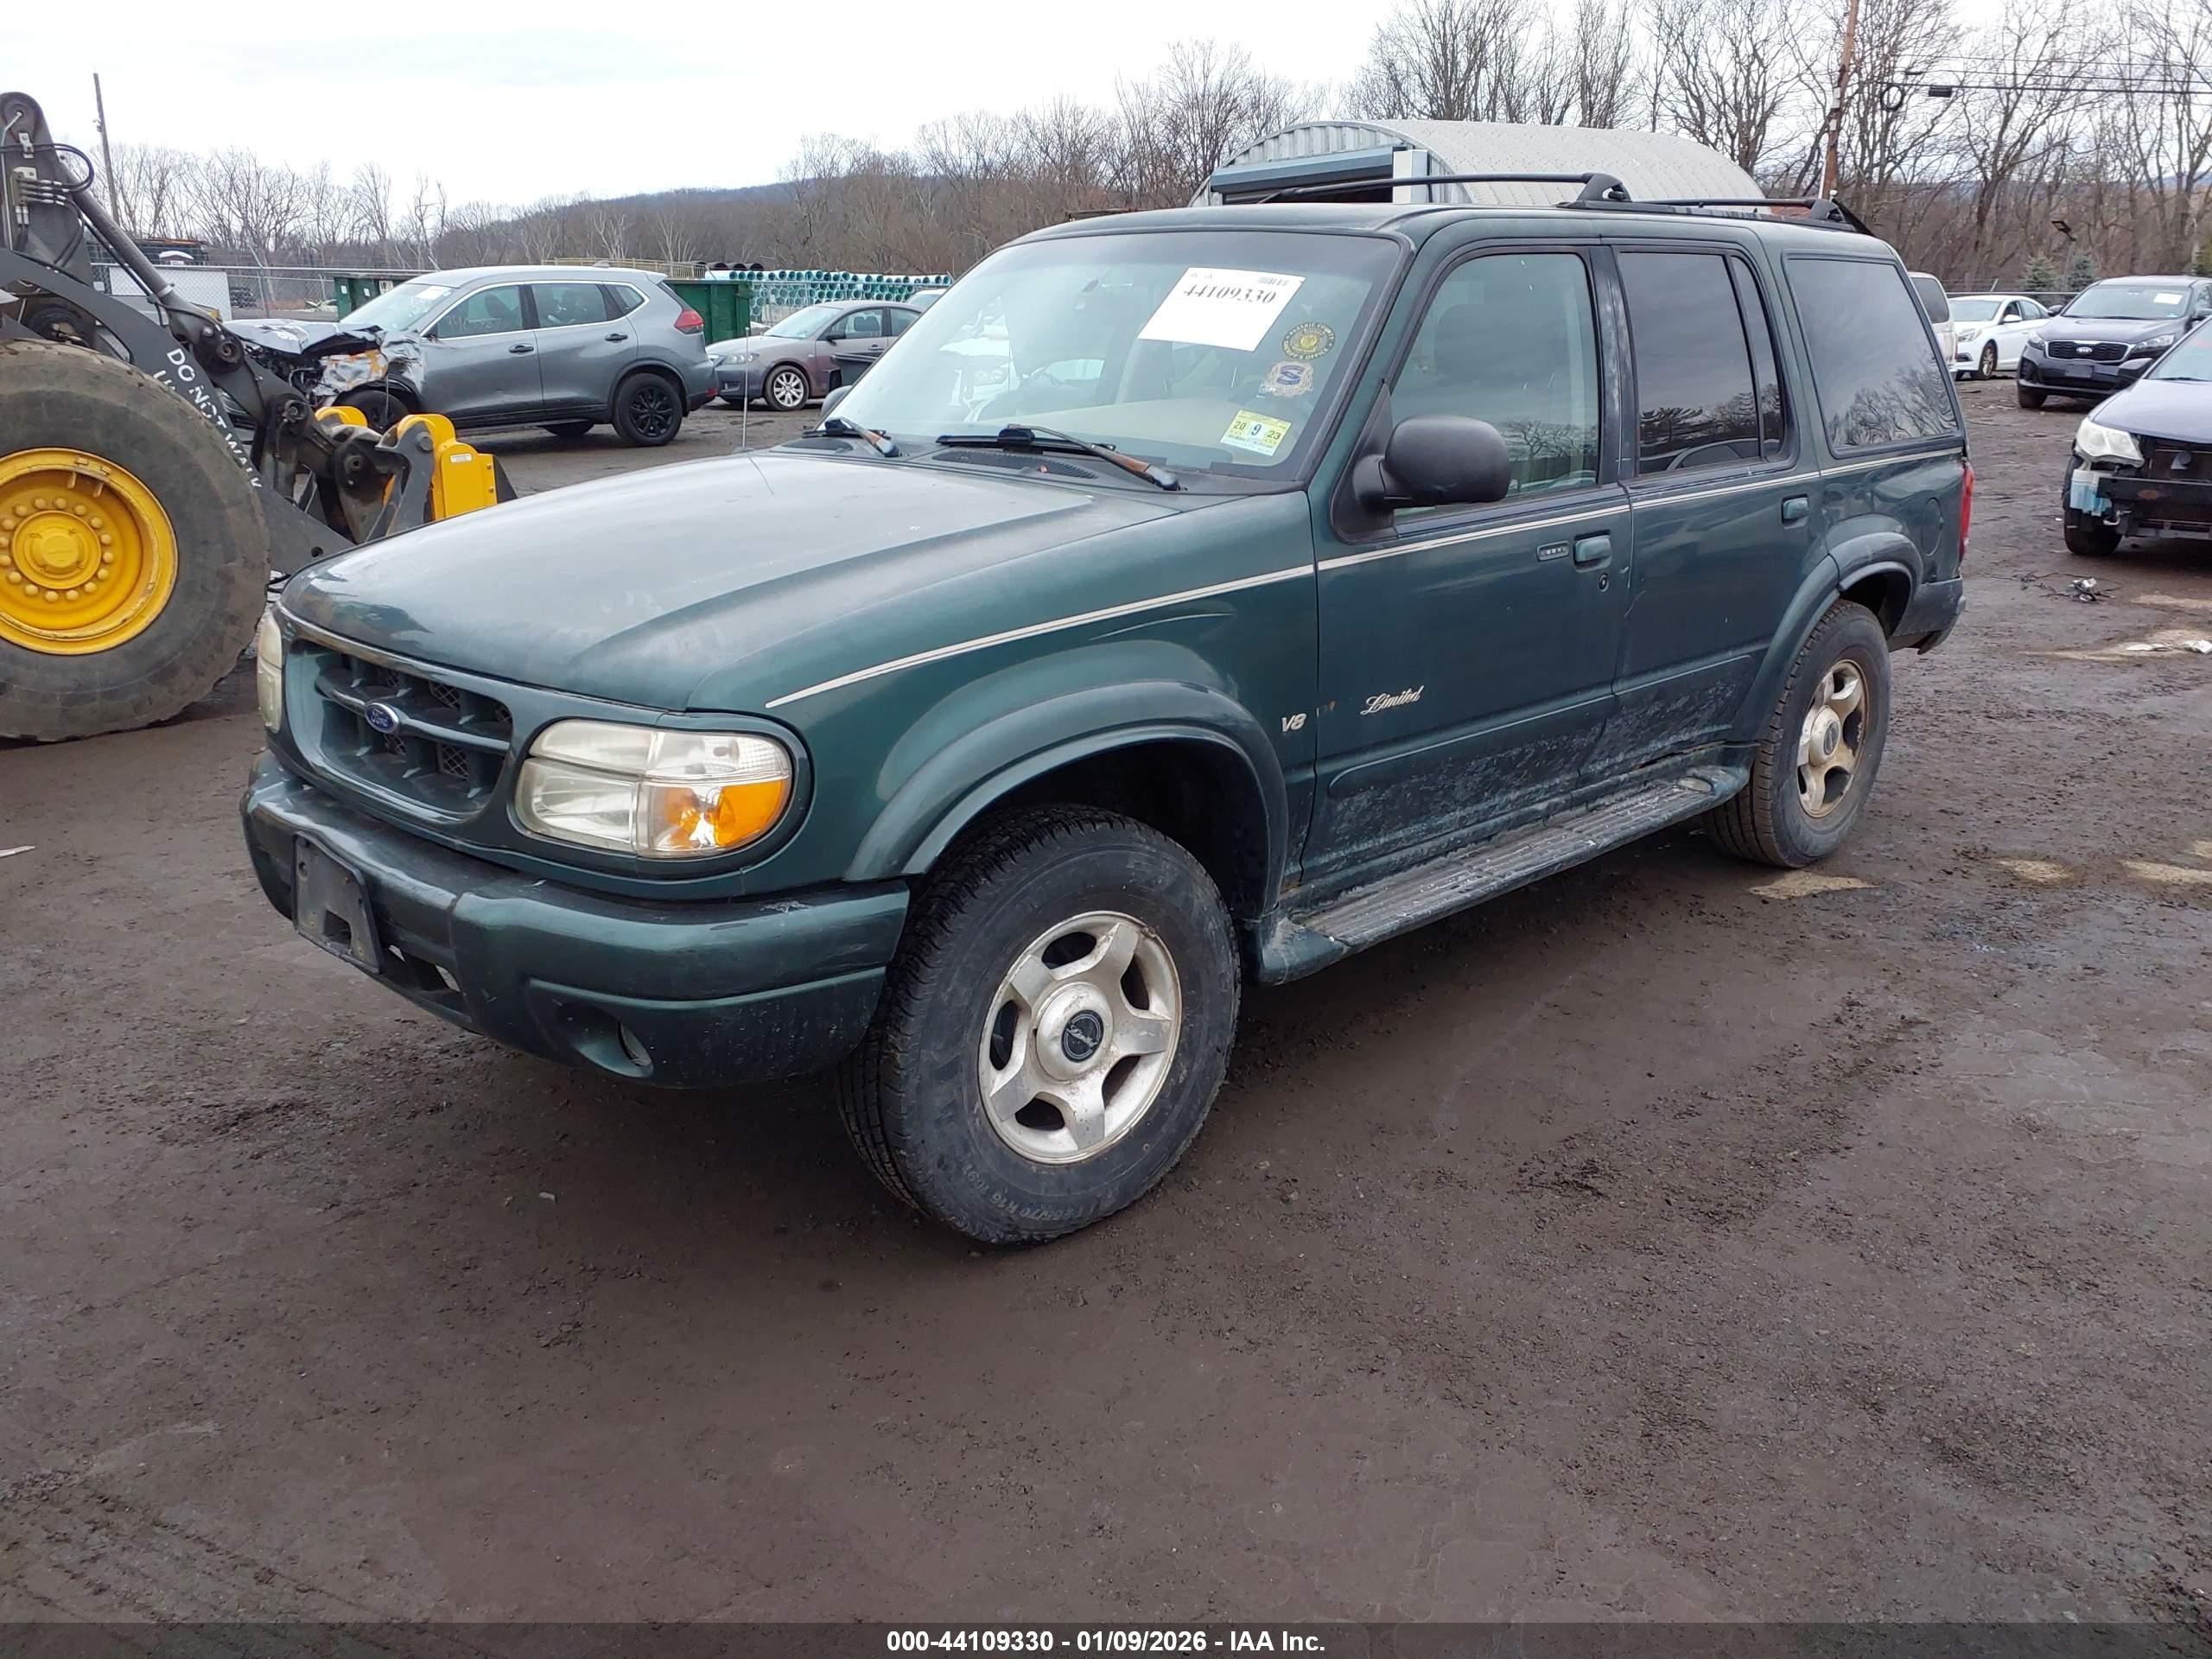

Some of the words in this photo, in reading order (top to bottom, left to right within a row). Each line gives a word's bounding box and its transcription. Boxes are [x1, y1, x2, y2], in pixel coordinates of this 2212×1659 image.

[1184, 284, 1277, 303] 44109330
[166, 347, 195, 382] DO
[188, 385, 227, 429] NOT
[1233, 421, 1247, 430] 20
[1251, 423, 1262, 436] 9
[1267, 430, 1281, 440] 23
[1360, 685, 1425, 715] Limited
[1281, 713, 1306, 733] V8
